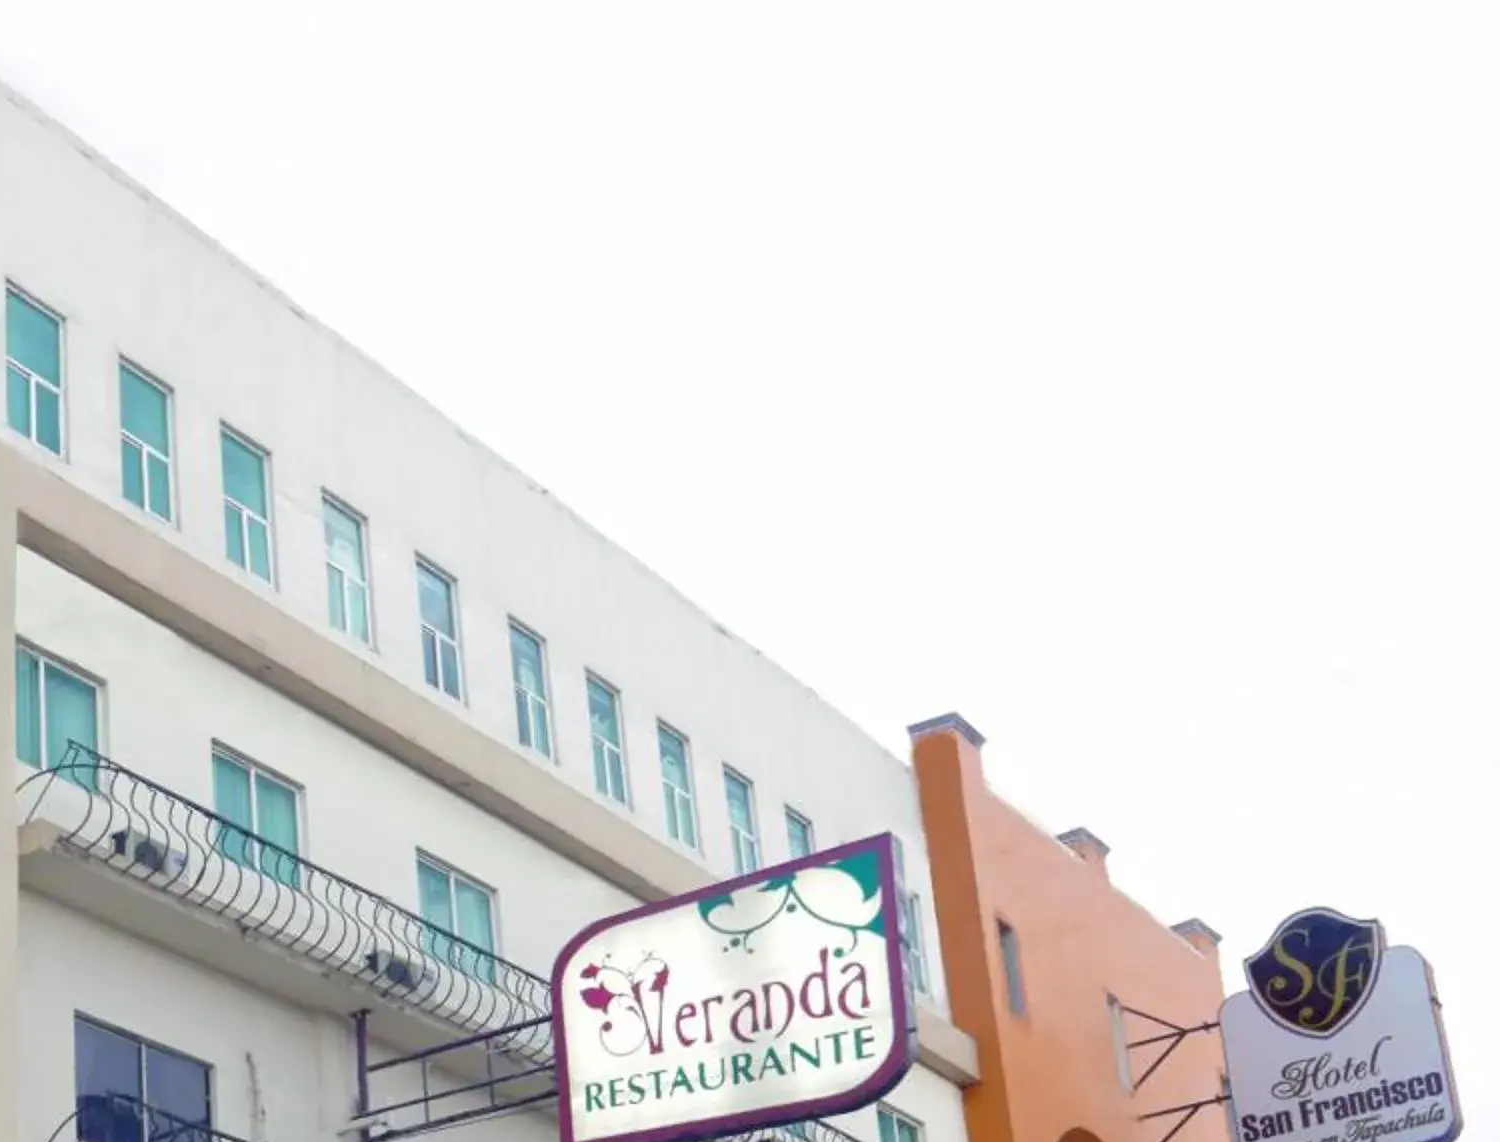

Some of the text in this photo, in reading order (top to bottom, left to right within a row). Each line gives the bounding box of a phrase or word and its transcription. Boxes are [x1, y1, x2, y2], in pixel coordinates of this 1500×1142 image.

[600, 947, 871, 1056] Veranda
[584, 1025, 876, 1112] RESTAURANTE
[1271, 1036, 1393, 1100] Hotel
[1297, 1070, 1445, 1129] Francisco
